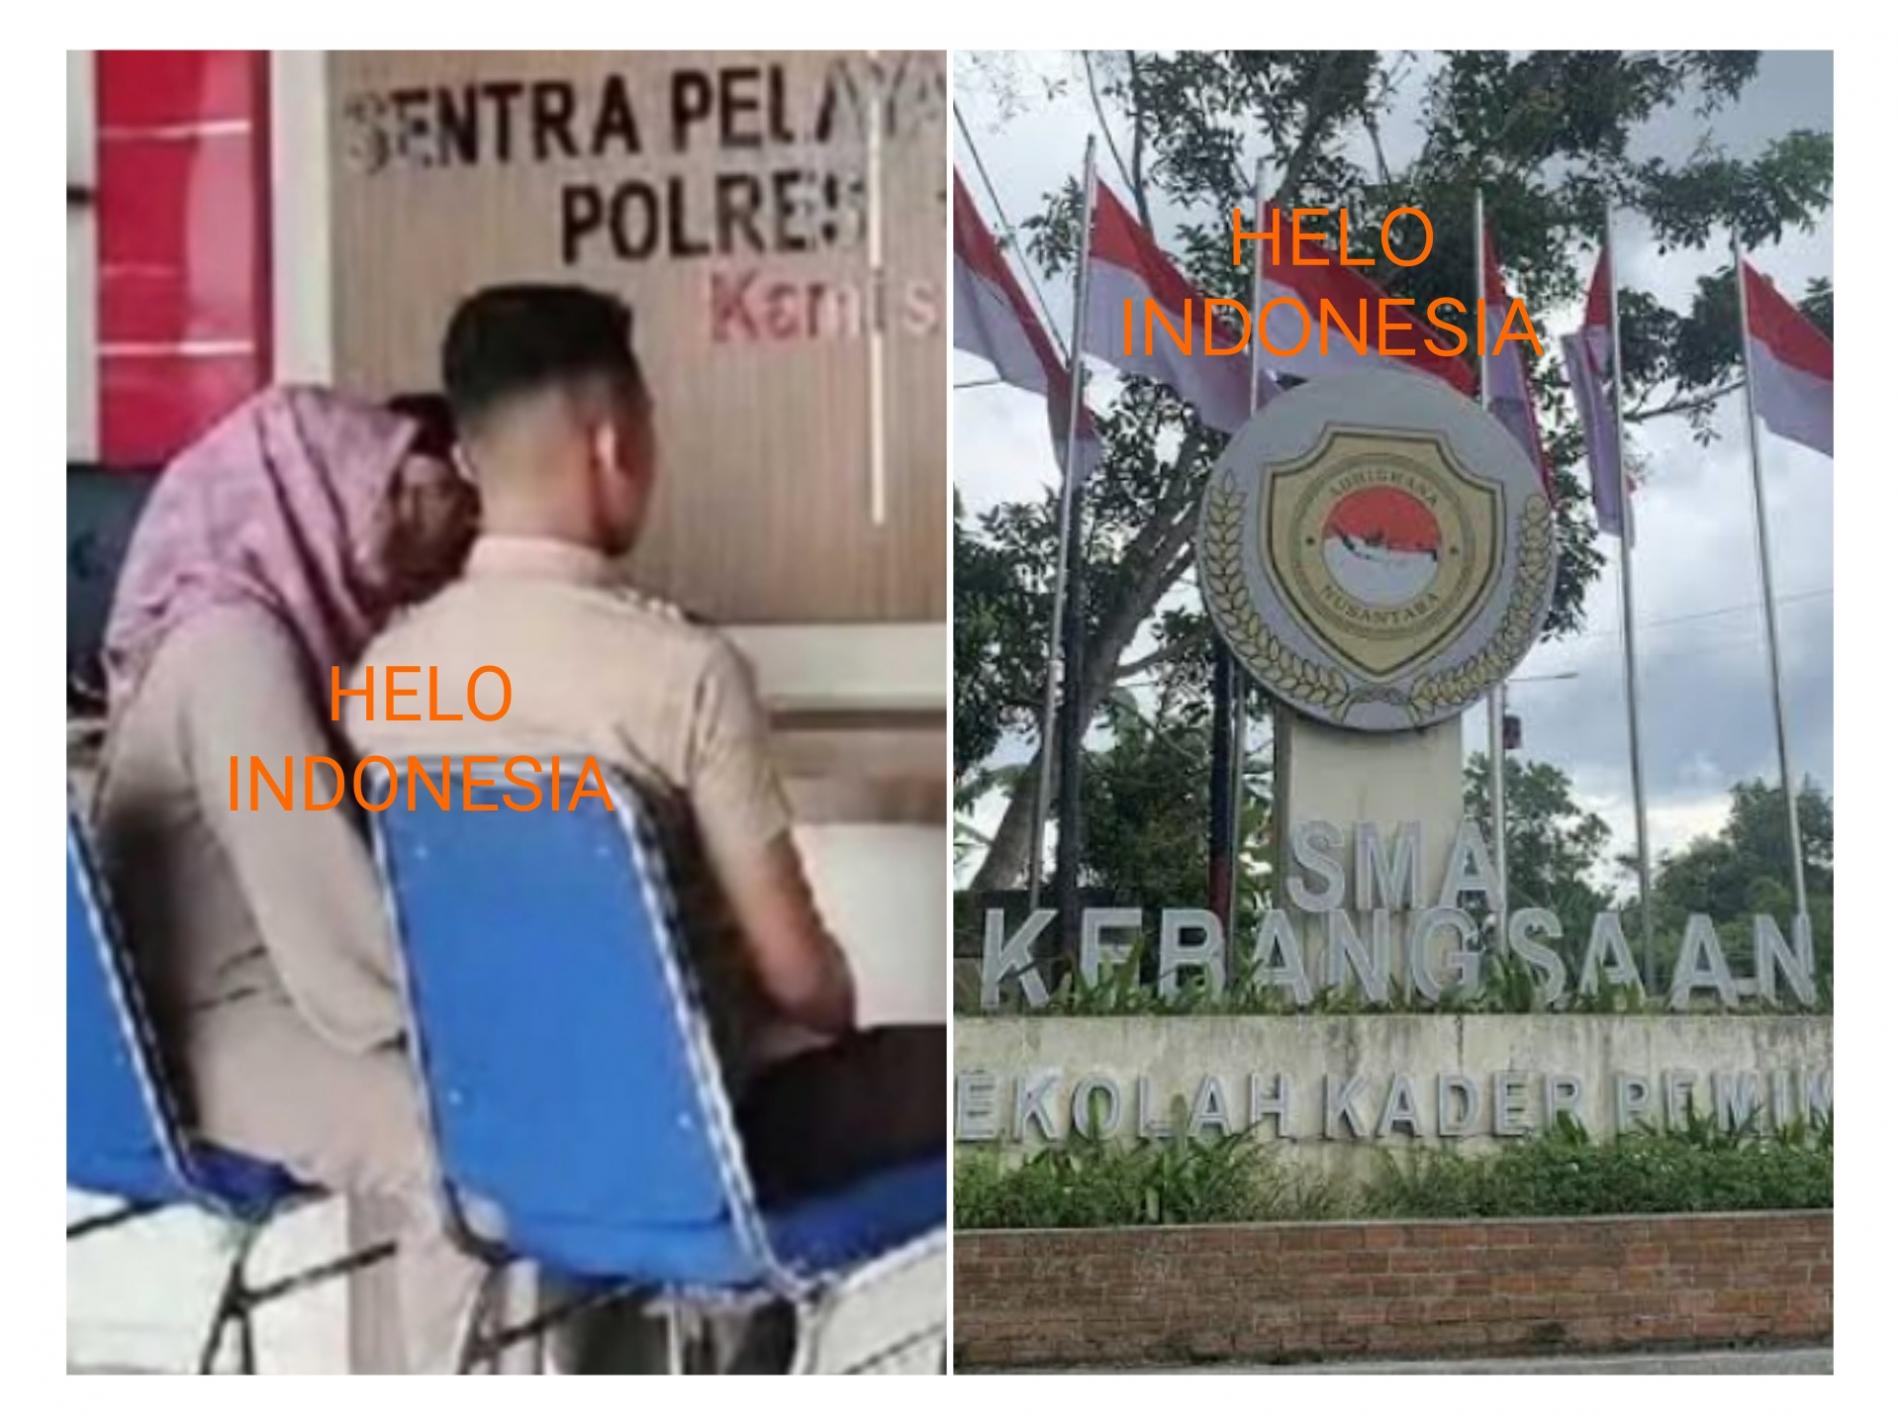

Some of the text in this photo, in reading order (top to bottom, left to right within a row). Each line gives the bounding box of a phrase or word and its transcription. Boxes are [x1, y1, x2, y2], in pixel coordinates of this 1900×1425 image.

[345, 73, 641, 176] SENTRA
[1287, 819, 1506, 913] SMA
[980, 906, 1817, 1010] KEBANGSAAN
[1323, 1071, 1589, 1139] KADER
